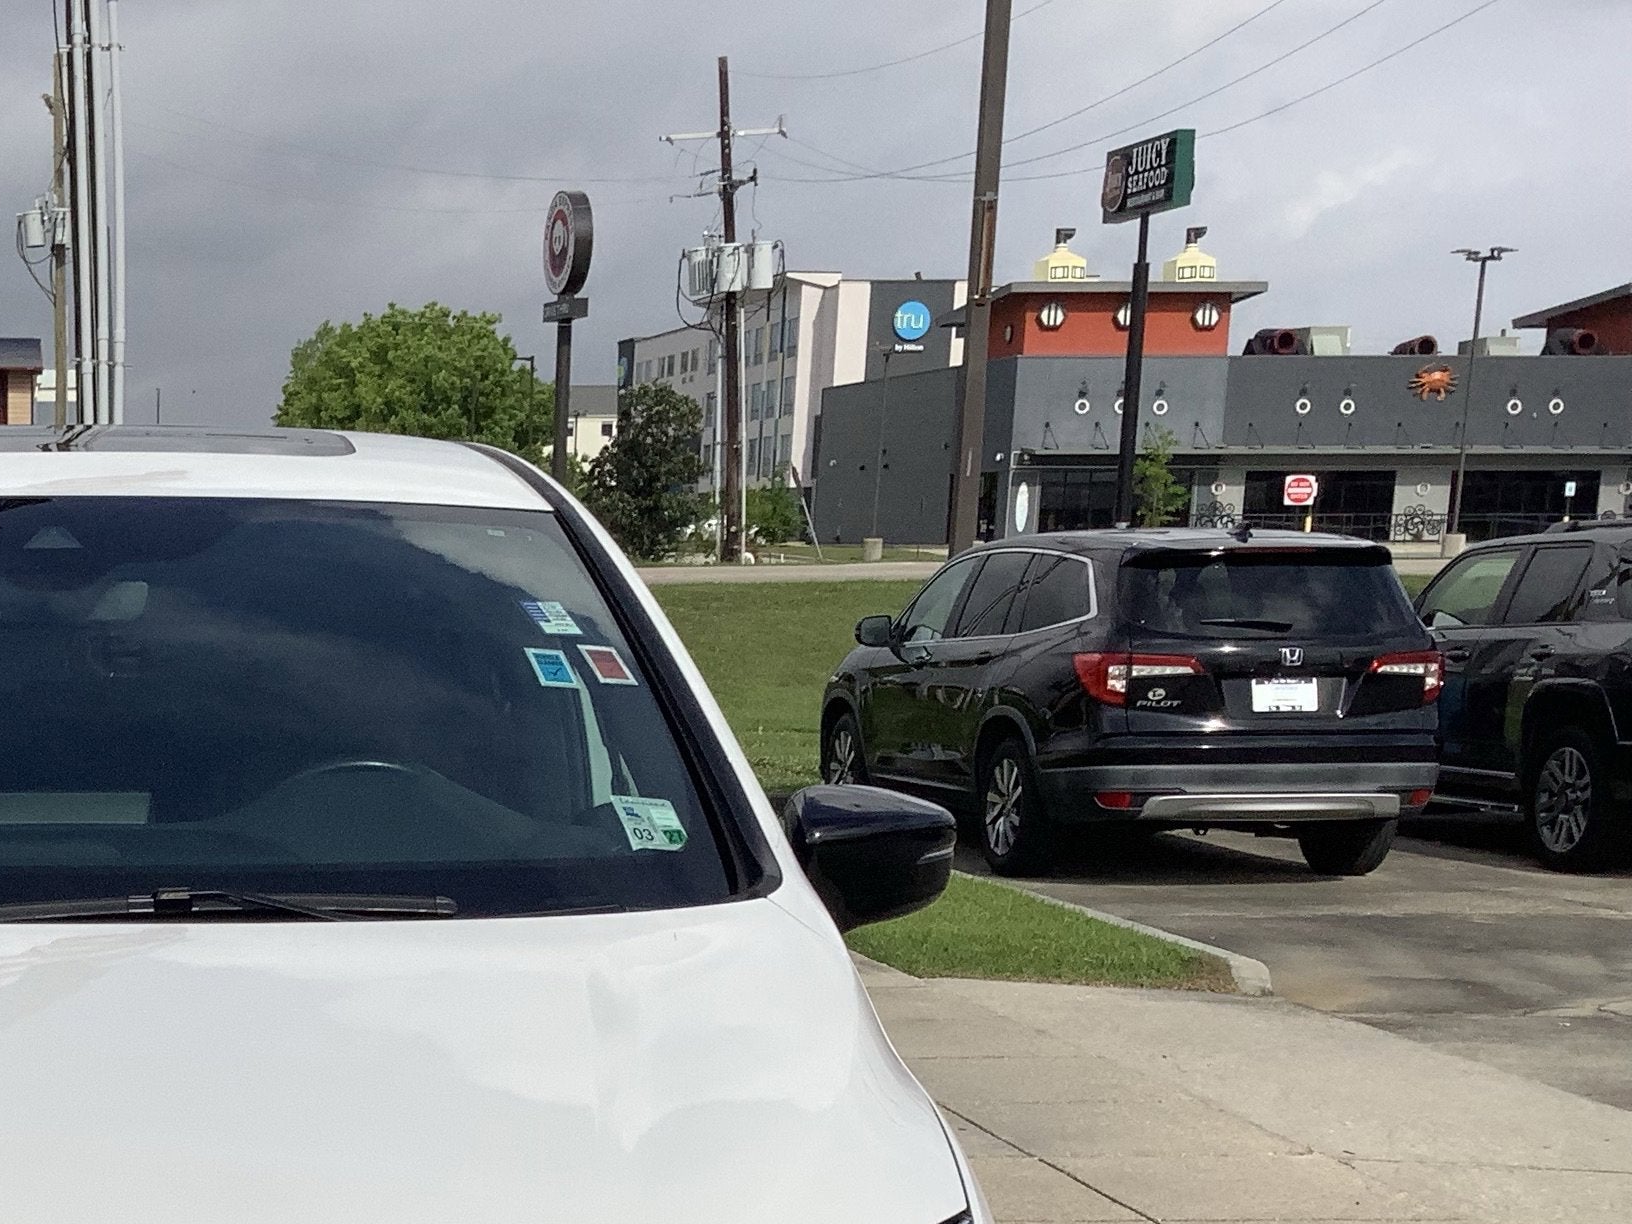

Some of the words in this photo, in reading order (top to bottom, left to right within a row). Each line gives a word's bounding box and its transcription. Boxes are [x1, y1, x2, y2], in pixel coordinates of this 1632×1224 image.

[1128, 138, 1170, 174] JUICY
[1128, 166, 1168, 194] SEAFOOD
[894, 310, 924, 329] tru
[633, 827, 654, 841] 03
